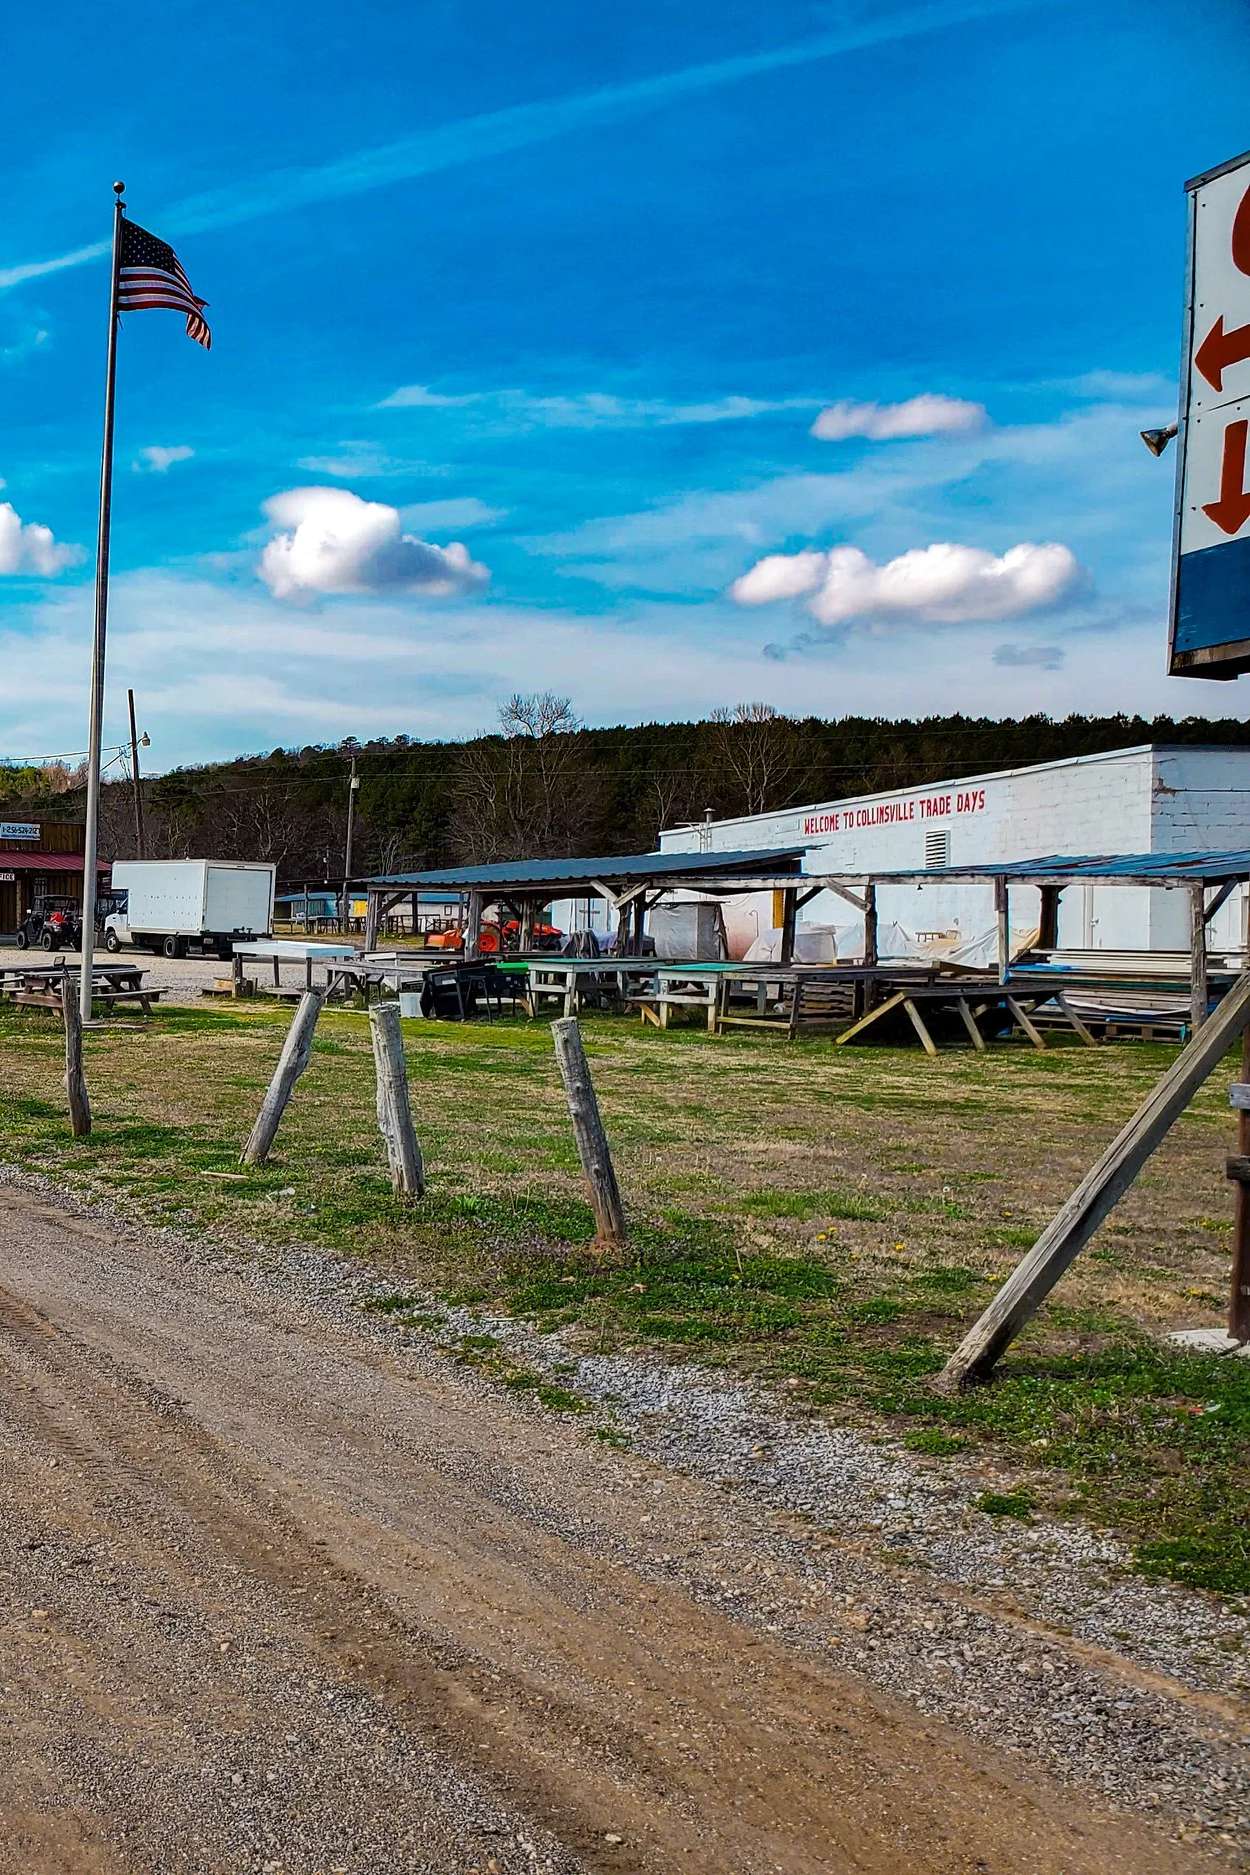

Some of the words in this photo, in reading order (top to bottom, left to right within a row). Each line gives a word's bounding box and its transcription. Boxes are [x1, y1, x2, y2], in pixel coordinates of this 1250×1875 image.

[804, 814, 840, 835] WELCOME
[843, 812, 854, 830] TO
[856, 802, 915, 827] COLLINSVILLE
[919, 795, 951, 819] TRADE
[956, 790, 986, 813] DAYS
